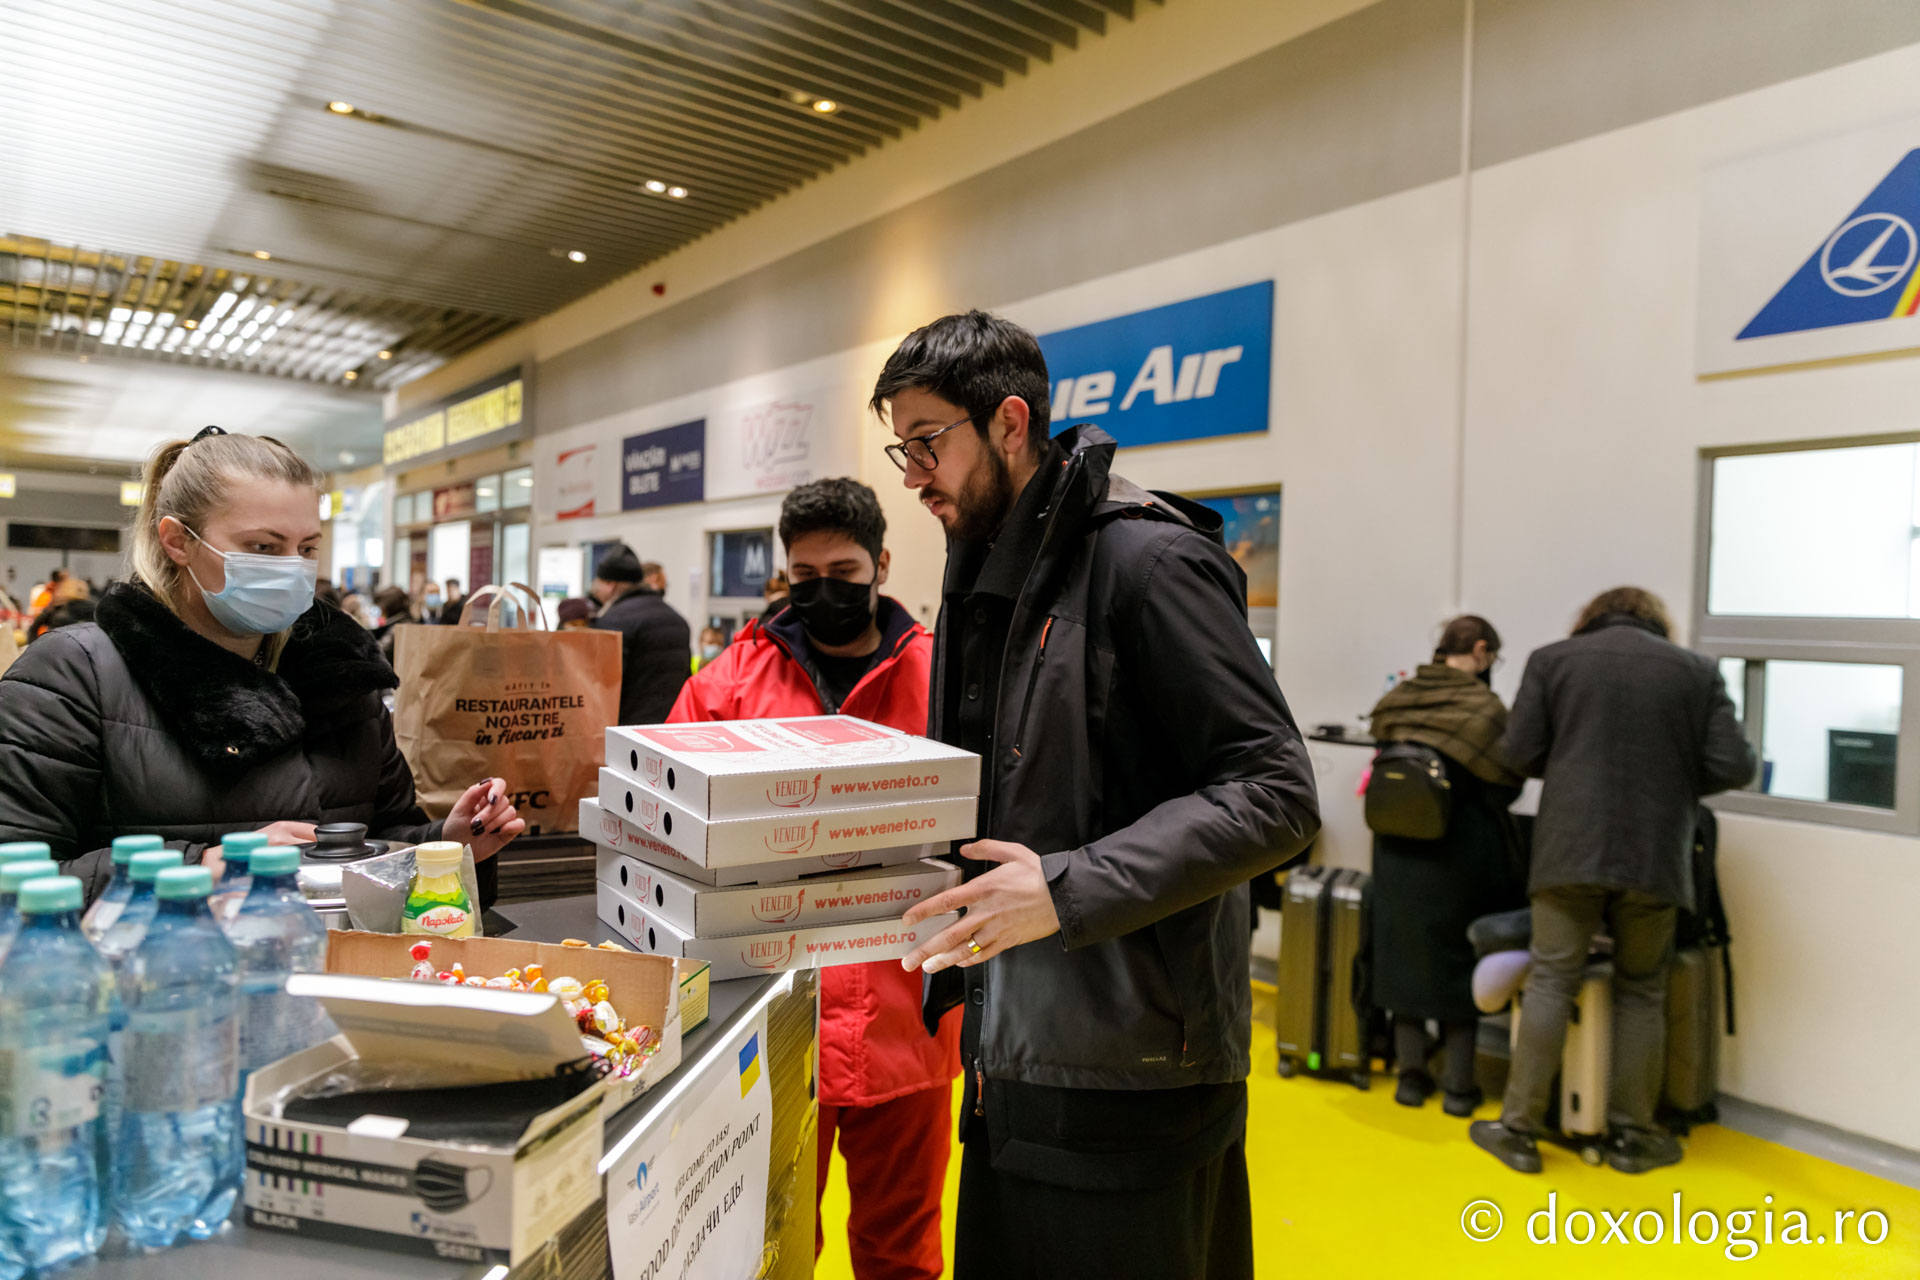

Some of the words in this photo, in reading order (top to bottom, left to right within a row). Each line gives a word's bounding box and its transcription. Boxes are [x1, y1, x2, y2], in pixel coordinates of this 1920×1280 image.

[1049, 370, 1117, 423] ue
[1119, 344, 1244, 411] Air
[455, 695, 585, 713] RESTAURANTELE
[475, 729, 494, 746] în
[497, 728, 549, 745] fiecare
[551, 724, 565, 738] zi
[775, 779, 808, 798] VENETO
[830, 774, 940, 795] www.veneto.ro
[773, 825, 807, 844] VENETO
[828, 817, 937, 840] www.veneto.ro
[760, 894, 792, 913] VENETO
[814, 887, 922, 910] www.veneto.ro
[421, 913, 465, 929] Napolact
[750, 940, 783, 959] VENETO
[805, 931, 917, 954] www.veneto.ro
[302, 1159, 359, 1181] MEDICAL
[671, 1144, 731, 1250] DISTRIBUTION
[731, 1112, 761, 1158] POINT
[674, 1149, 706, 1200] WELCOME
[706, 1138, 715, 1158] TO
[723, 1173, 744, 1215] ЕДЫ
[251, 1210, 299, 1231] BLACK
